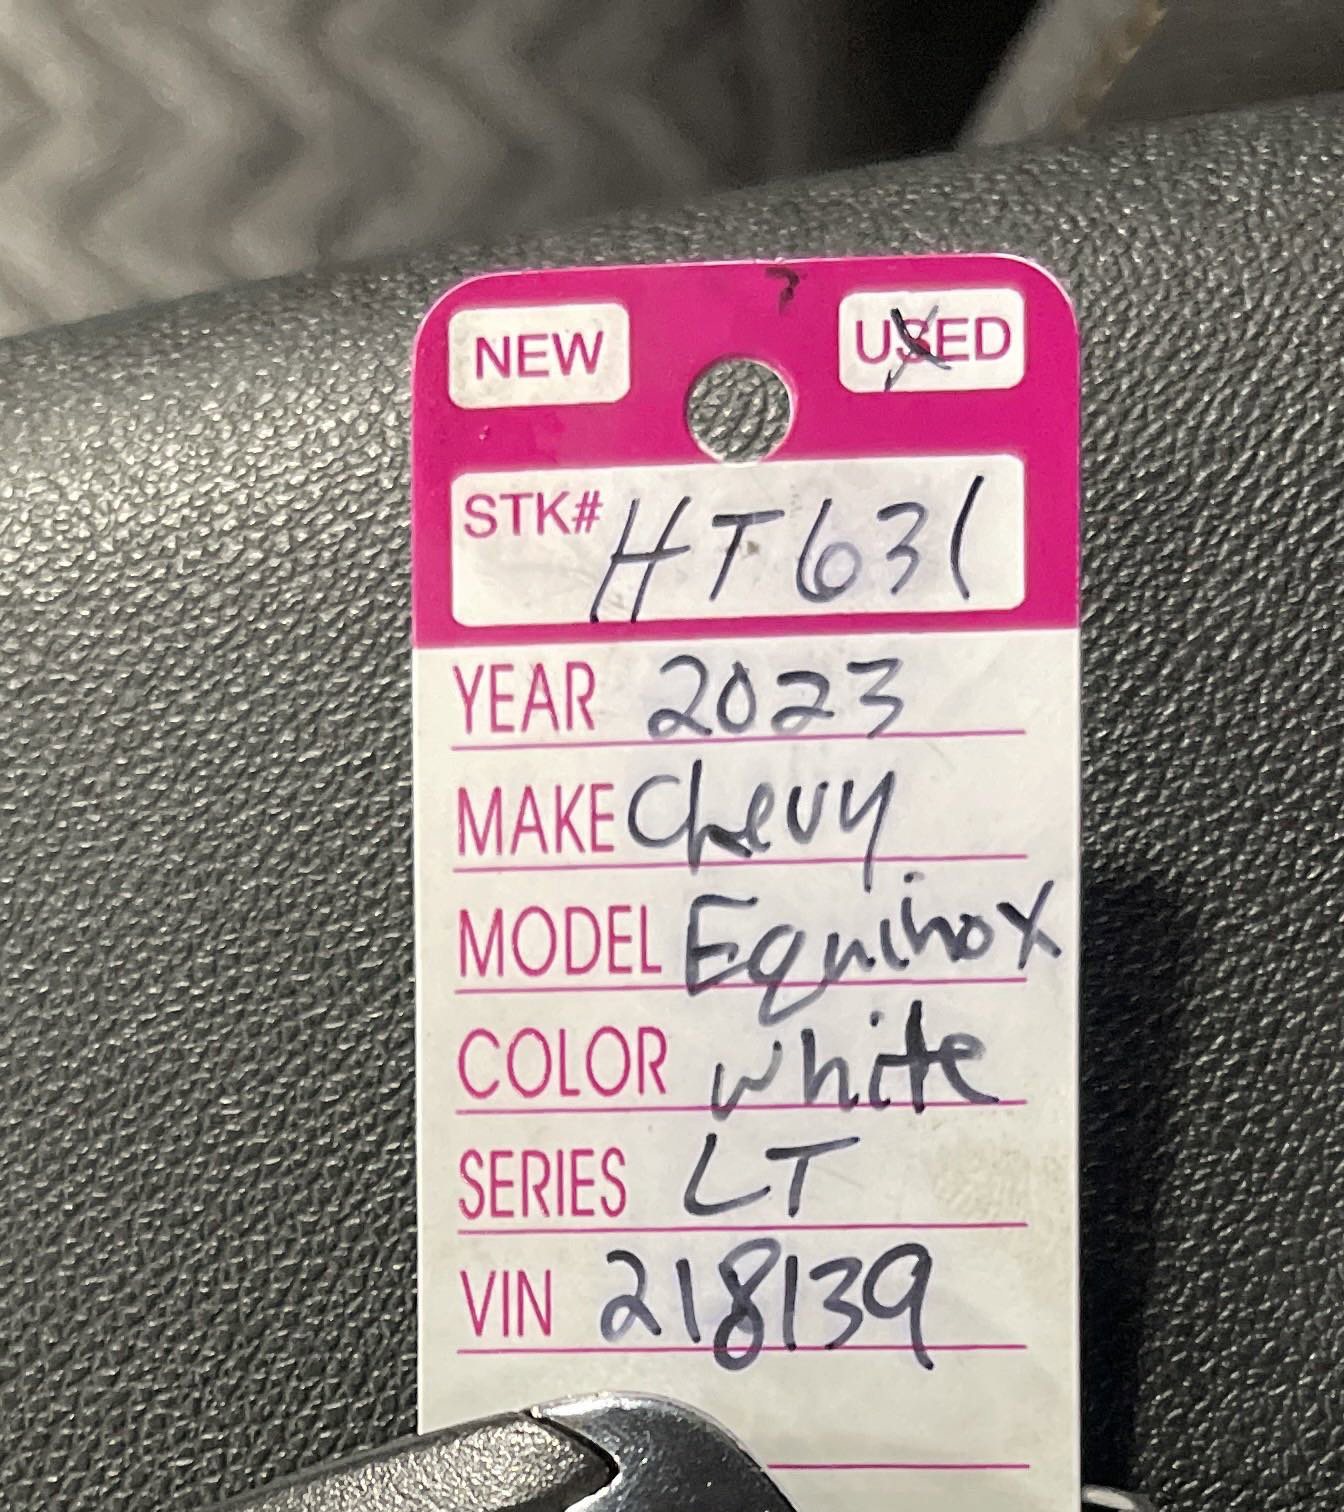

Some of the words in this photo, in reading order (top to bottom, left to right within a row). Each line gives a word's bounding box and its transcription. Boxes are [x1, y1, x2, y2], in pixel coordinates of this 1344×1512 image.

[475, 331, 605, 378] NEW
[856, 317, 1012, 363] USED
[463, 491, 603, 540] STK#
[453, 661, 596, 733] YEAR
[647, 654, 906, 739] 2023
[457, 783, 616, 855] MAKE
[627, 759, 897, 892] Chevy
[459, 905, 662, 977] MODEL
[685, 872, 1062, 1026] Equinox
[457, 1026, 668, 1100] COLOR
[459, 1146, 627, 1219] SERIES
[683, 1132, 861, 1217] LT
[460, 1269, 553, 1337] VIN
[600, 1238, 936, 1372] 218139
